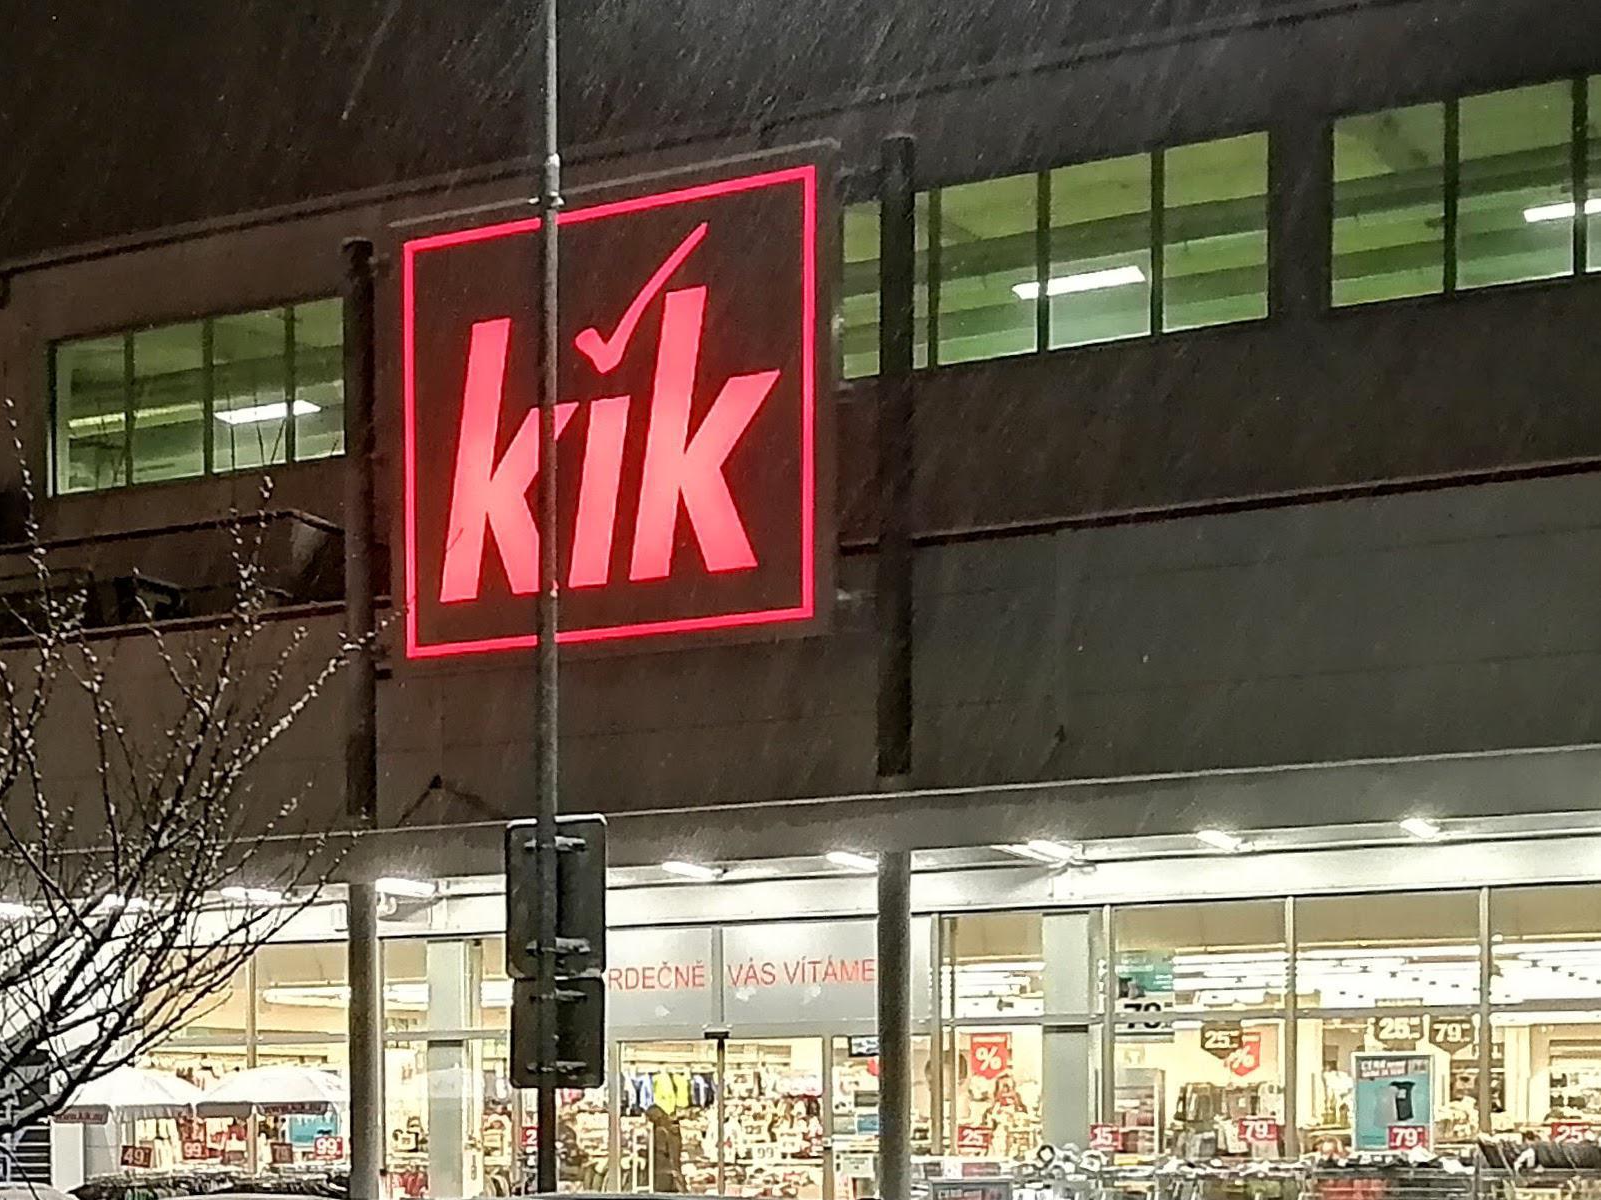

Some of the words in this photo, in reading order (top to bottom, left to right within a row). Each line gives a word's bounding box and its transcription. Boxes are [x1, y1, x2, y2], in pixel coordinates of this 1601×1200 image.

[440, 223, 781, 604] kik
[607, 961, 705, 990] RDEČNĚ
[727, 957, 777, 988] VÁS
[784, 954, 877, 986] VÍTÁME
